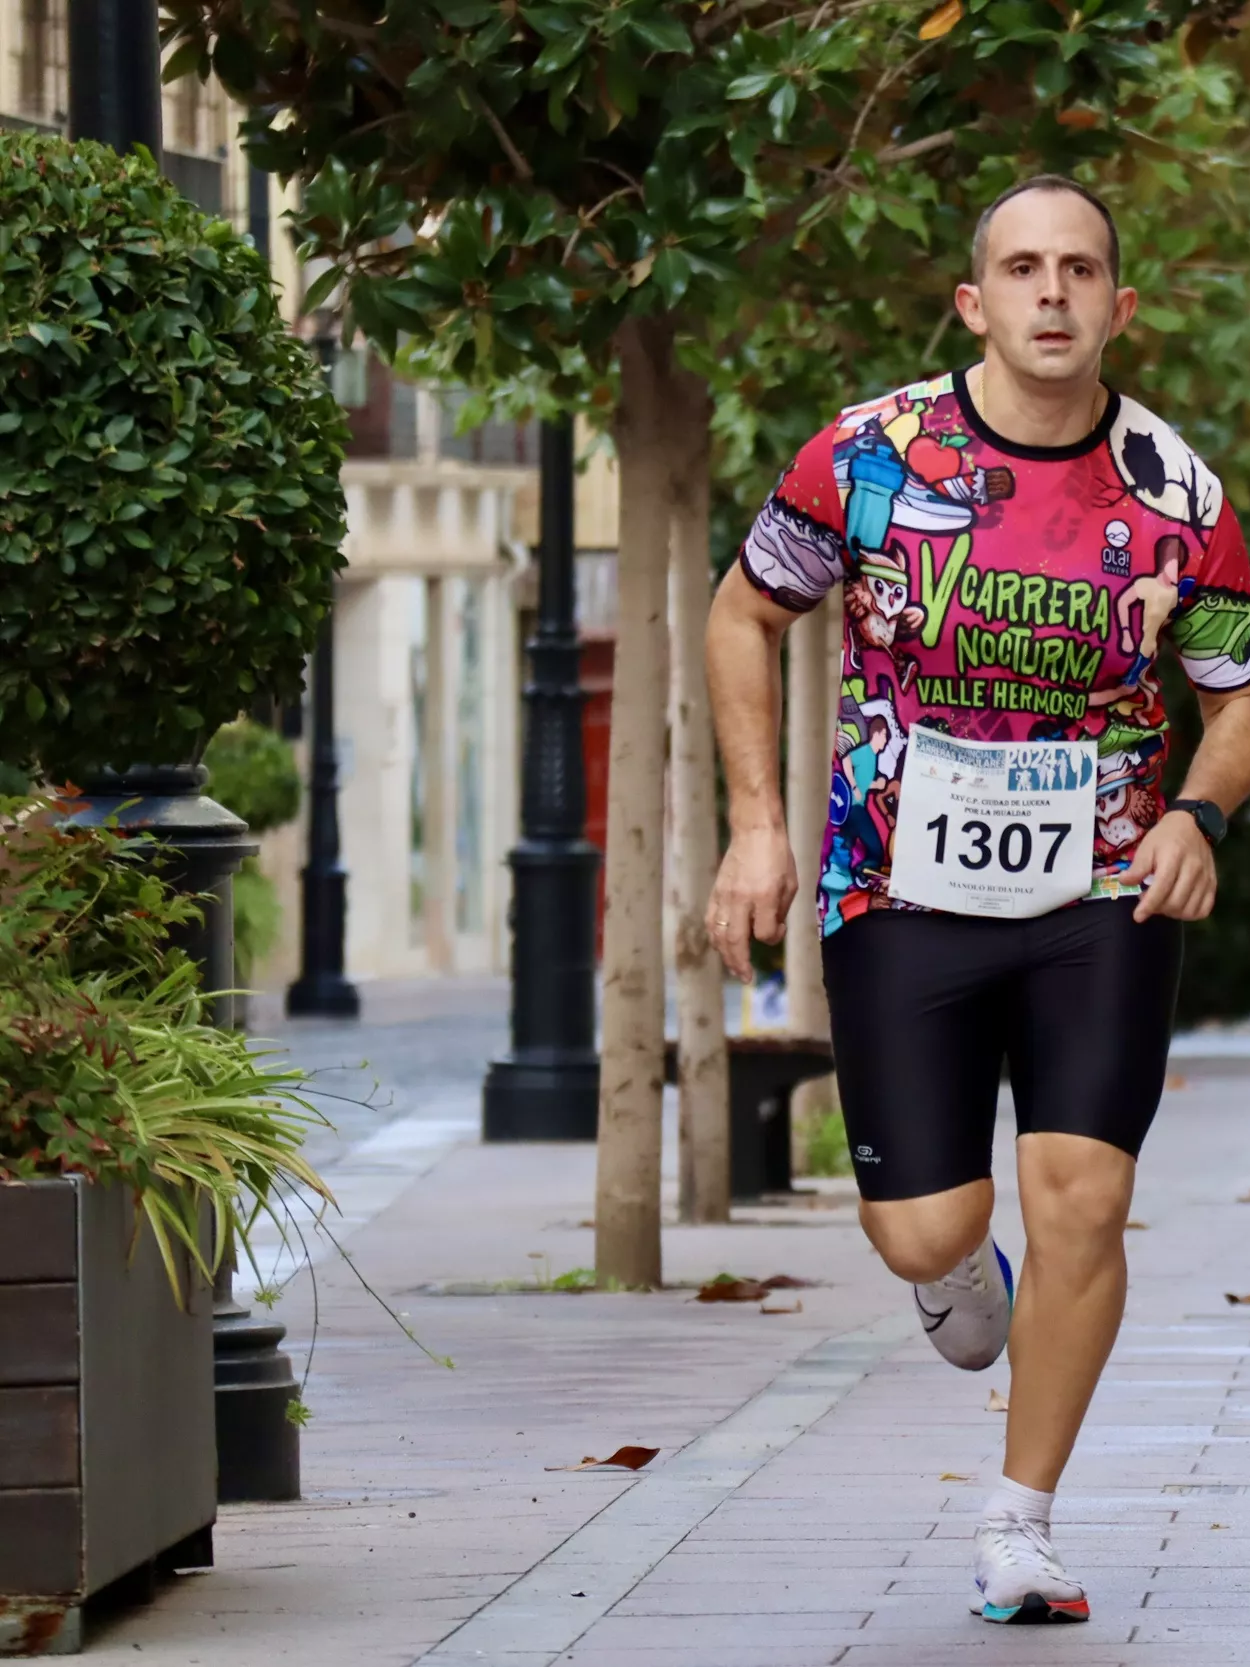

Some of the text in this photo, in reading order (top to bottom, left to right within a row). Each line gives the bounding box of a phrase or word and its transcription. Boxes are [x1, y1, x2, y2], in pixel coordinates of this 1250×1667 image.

[921, 533, 1109, 648] V CARRERA
[957, 626, 1102, 688] NOCTURNA
[917, 678, 1088, 719] VALLE HERMOSO
[958, 751, 1006, 769] POPULARES
[1008, 748, 1057, 769] 2024
[949, 793, 964, 803] XXV
[981, 798, 1009, 807] CIUDAD
[1011, 799, 1020, 807] DE
[1022, 799, 1050, 807] LUCENA
[964, 807, 979, 815] POR
[980, 808, 991, 816] LA
[927, 814, 1072, 873] 1307
[949, 880, 986, 891] MANOLO
[1014, 886, 1035, 895] DIAZ
